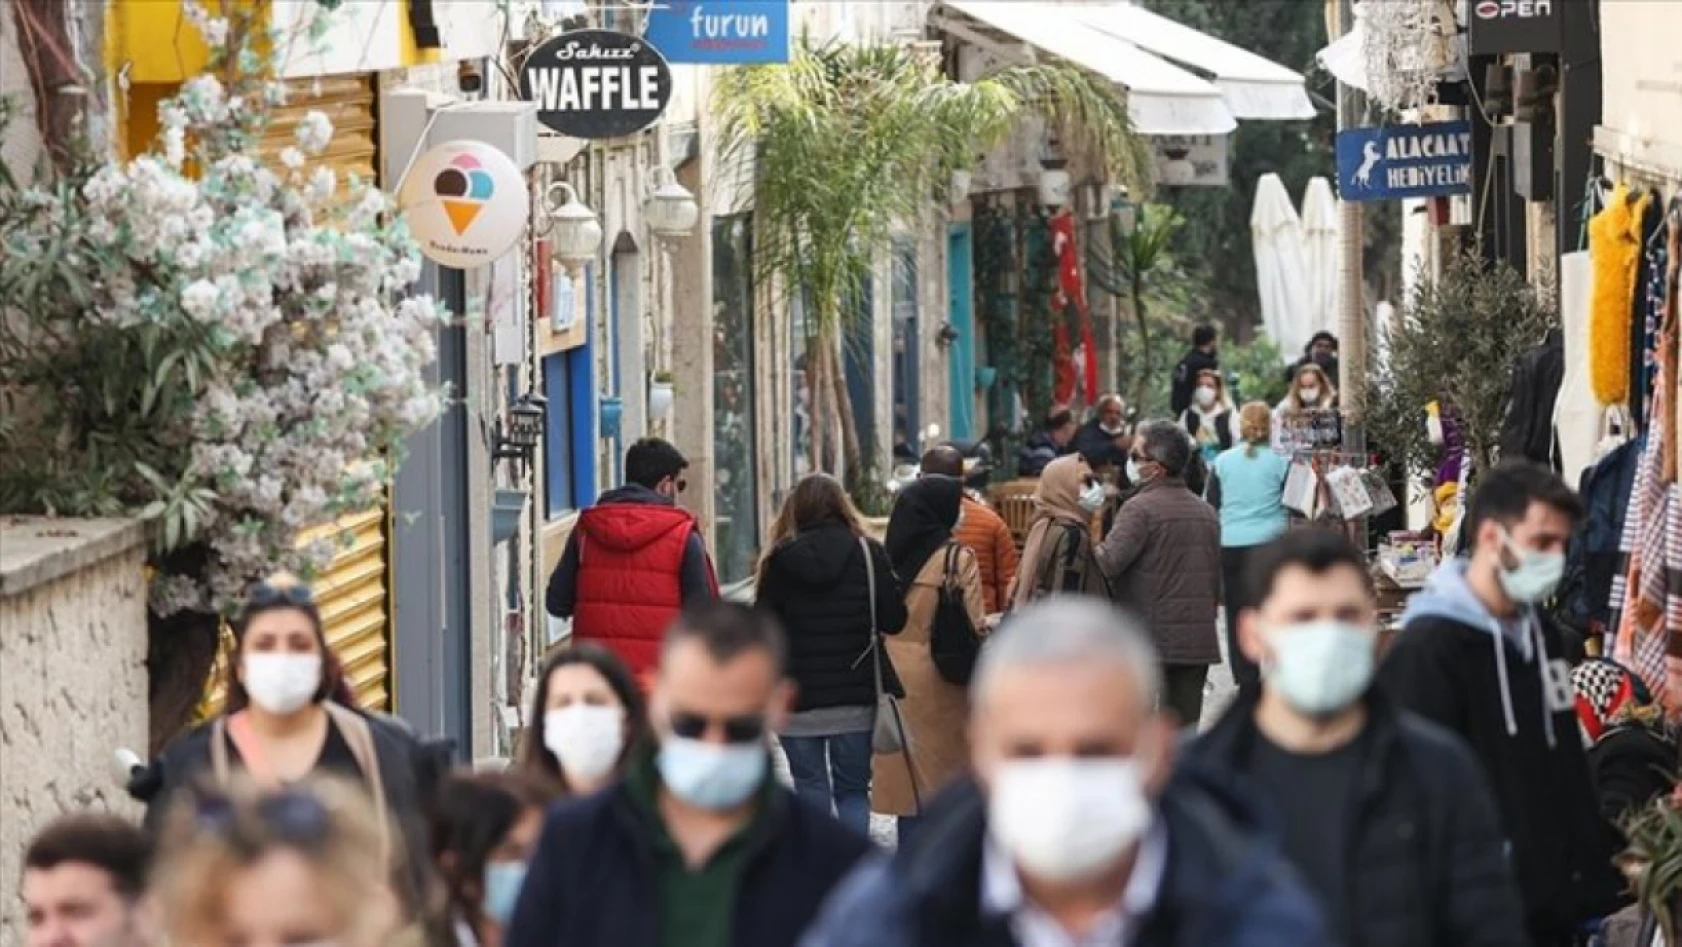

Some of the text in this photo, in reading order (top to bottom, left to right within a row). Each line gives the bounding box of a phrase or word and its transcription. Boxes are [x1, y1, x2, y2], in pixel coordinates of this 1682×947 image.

[690, 5, 768, 37] furun
[1475, 0, 1552, 19] OPEN
[528, 65, 660, 110] WAFFLE
